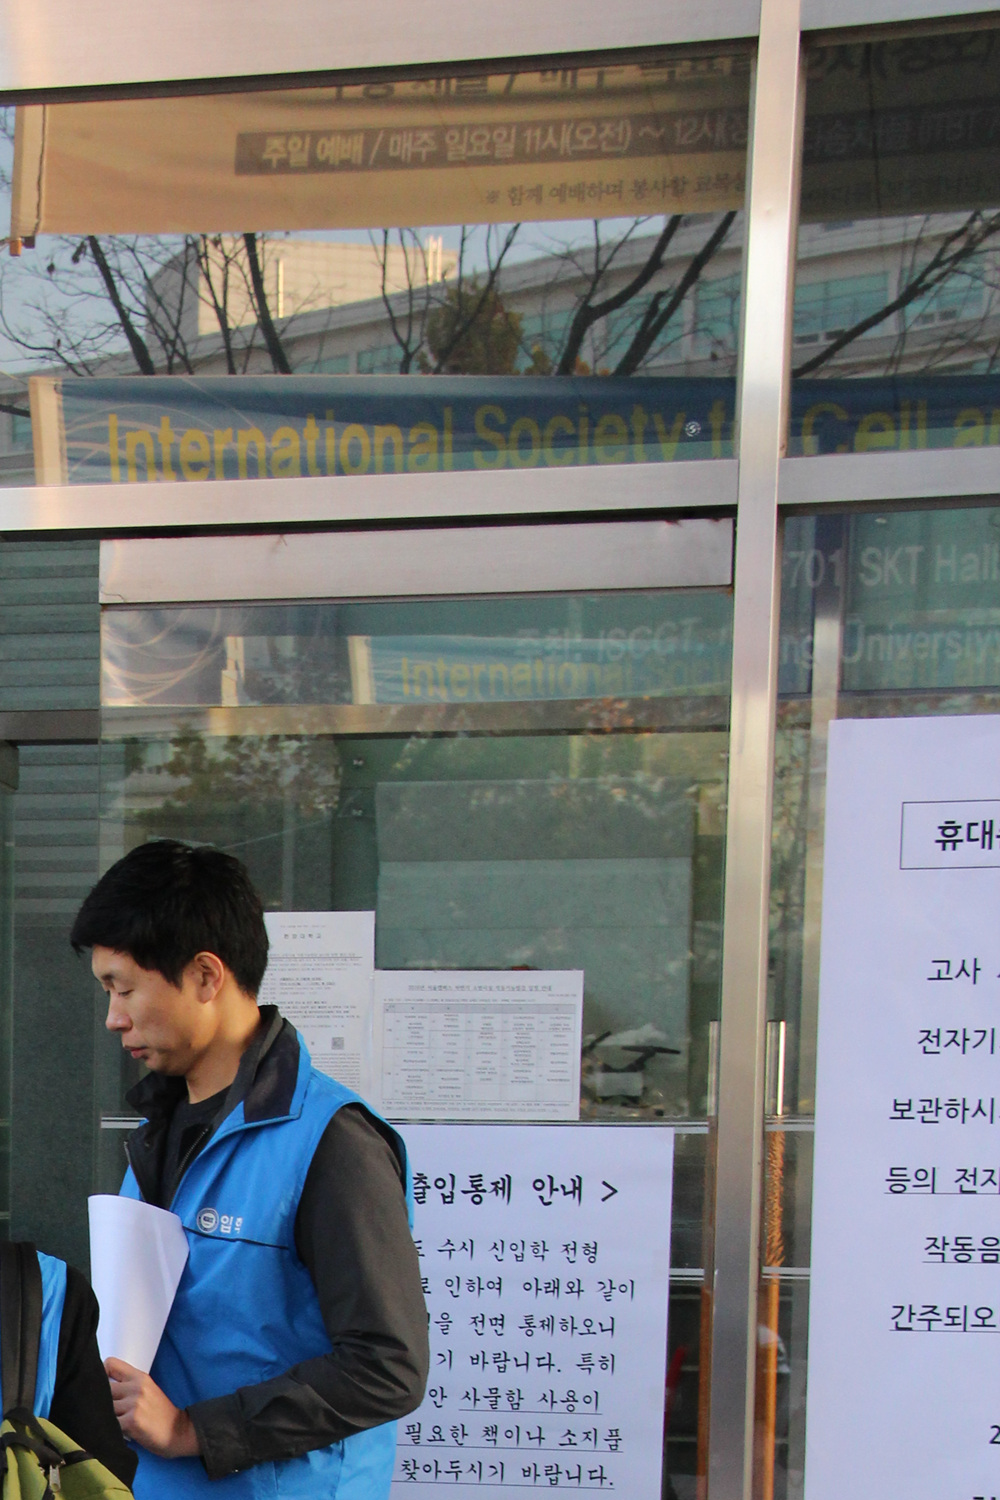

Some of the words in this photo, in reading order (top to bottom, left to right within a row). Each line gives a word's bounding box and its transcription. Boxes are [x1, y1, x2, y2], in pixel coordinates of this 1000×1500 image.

[262, 135, 310, 168] 주일
[317, 132, 364, 166] 예배
[389, 129, 437, 163] 매주
[445, 126, 516, 162] 일요일
[523, 118, 632, 155] 11시(오전)
[109, 407, 453, 482] International
[472, 404, 686, 469] Society
[803, 399, 927, 457] Cell
[859, 546, 924, 586] SKT
[402, 654, 633, 697] International
[935, 820, 1000, 851] 휴대
[927, 957, 981, 985] 고사
[918, 1027, 1000, 1056] 전자기
[889, 1097, 1000, 1124] 보관하시
[532, 1175, 583, 1206] 안내
[885, 1166, 936, 1194] 등의
[437, 1239, 474, 1261] 수시
[489, 1239, 549, 1263] 신입학
[562, 1241, 598, 1264] 전형
[924, 1236, 1000, 1263] 작동음
[445, 1276, 502, 1299] 인하여
[523, 1277, 584, 1300] 아래와
[597, 1279, 635, 1302] 같이
[427, 1312, 453, 1336] 을
[470, 1313, 505, 1337] 전면
[518, 1314, 615, 1338] 통제하오니
[890, 1304, 1000, 1332] 간주되오
[469, 1350, 562, 1374] 바랍니다.
[576, 1352, 616, 1376] 특히
[428, 1386, 448, 1409] 안
[461, 1387, 525, 1411] 사물함
[537, 1389, 602, 1413] 사용이
[404, 1421, 469, 1446] 필요한
[481, 1424, 546, 1448] 책이나
[558, 1426, 623, 1452] 소지품
[400, 1459, 505, 1483] 찾아두시기
[521, 1463, 614, 1487] 바랍니다.
